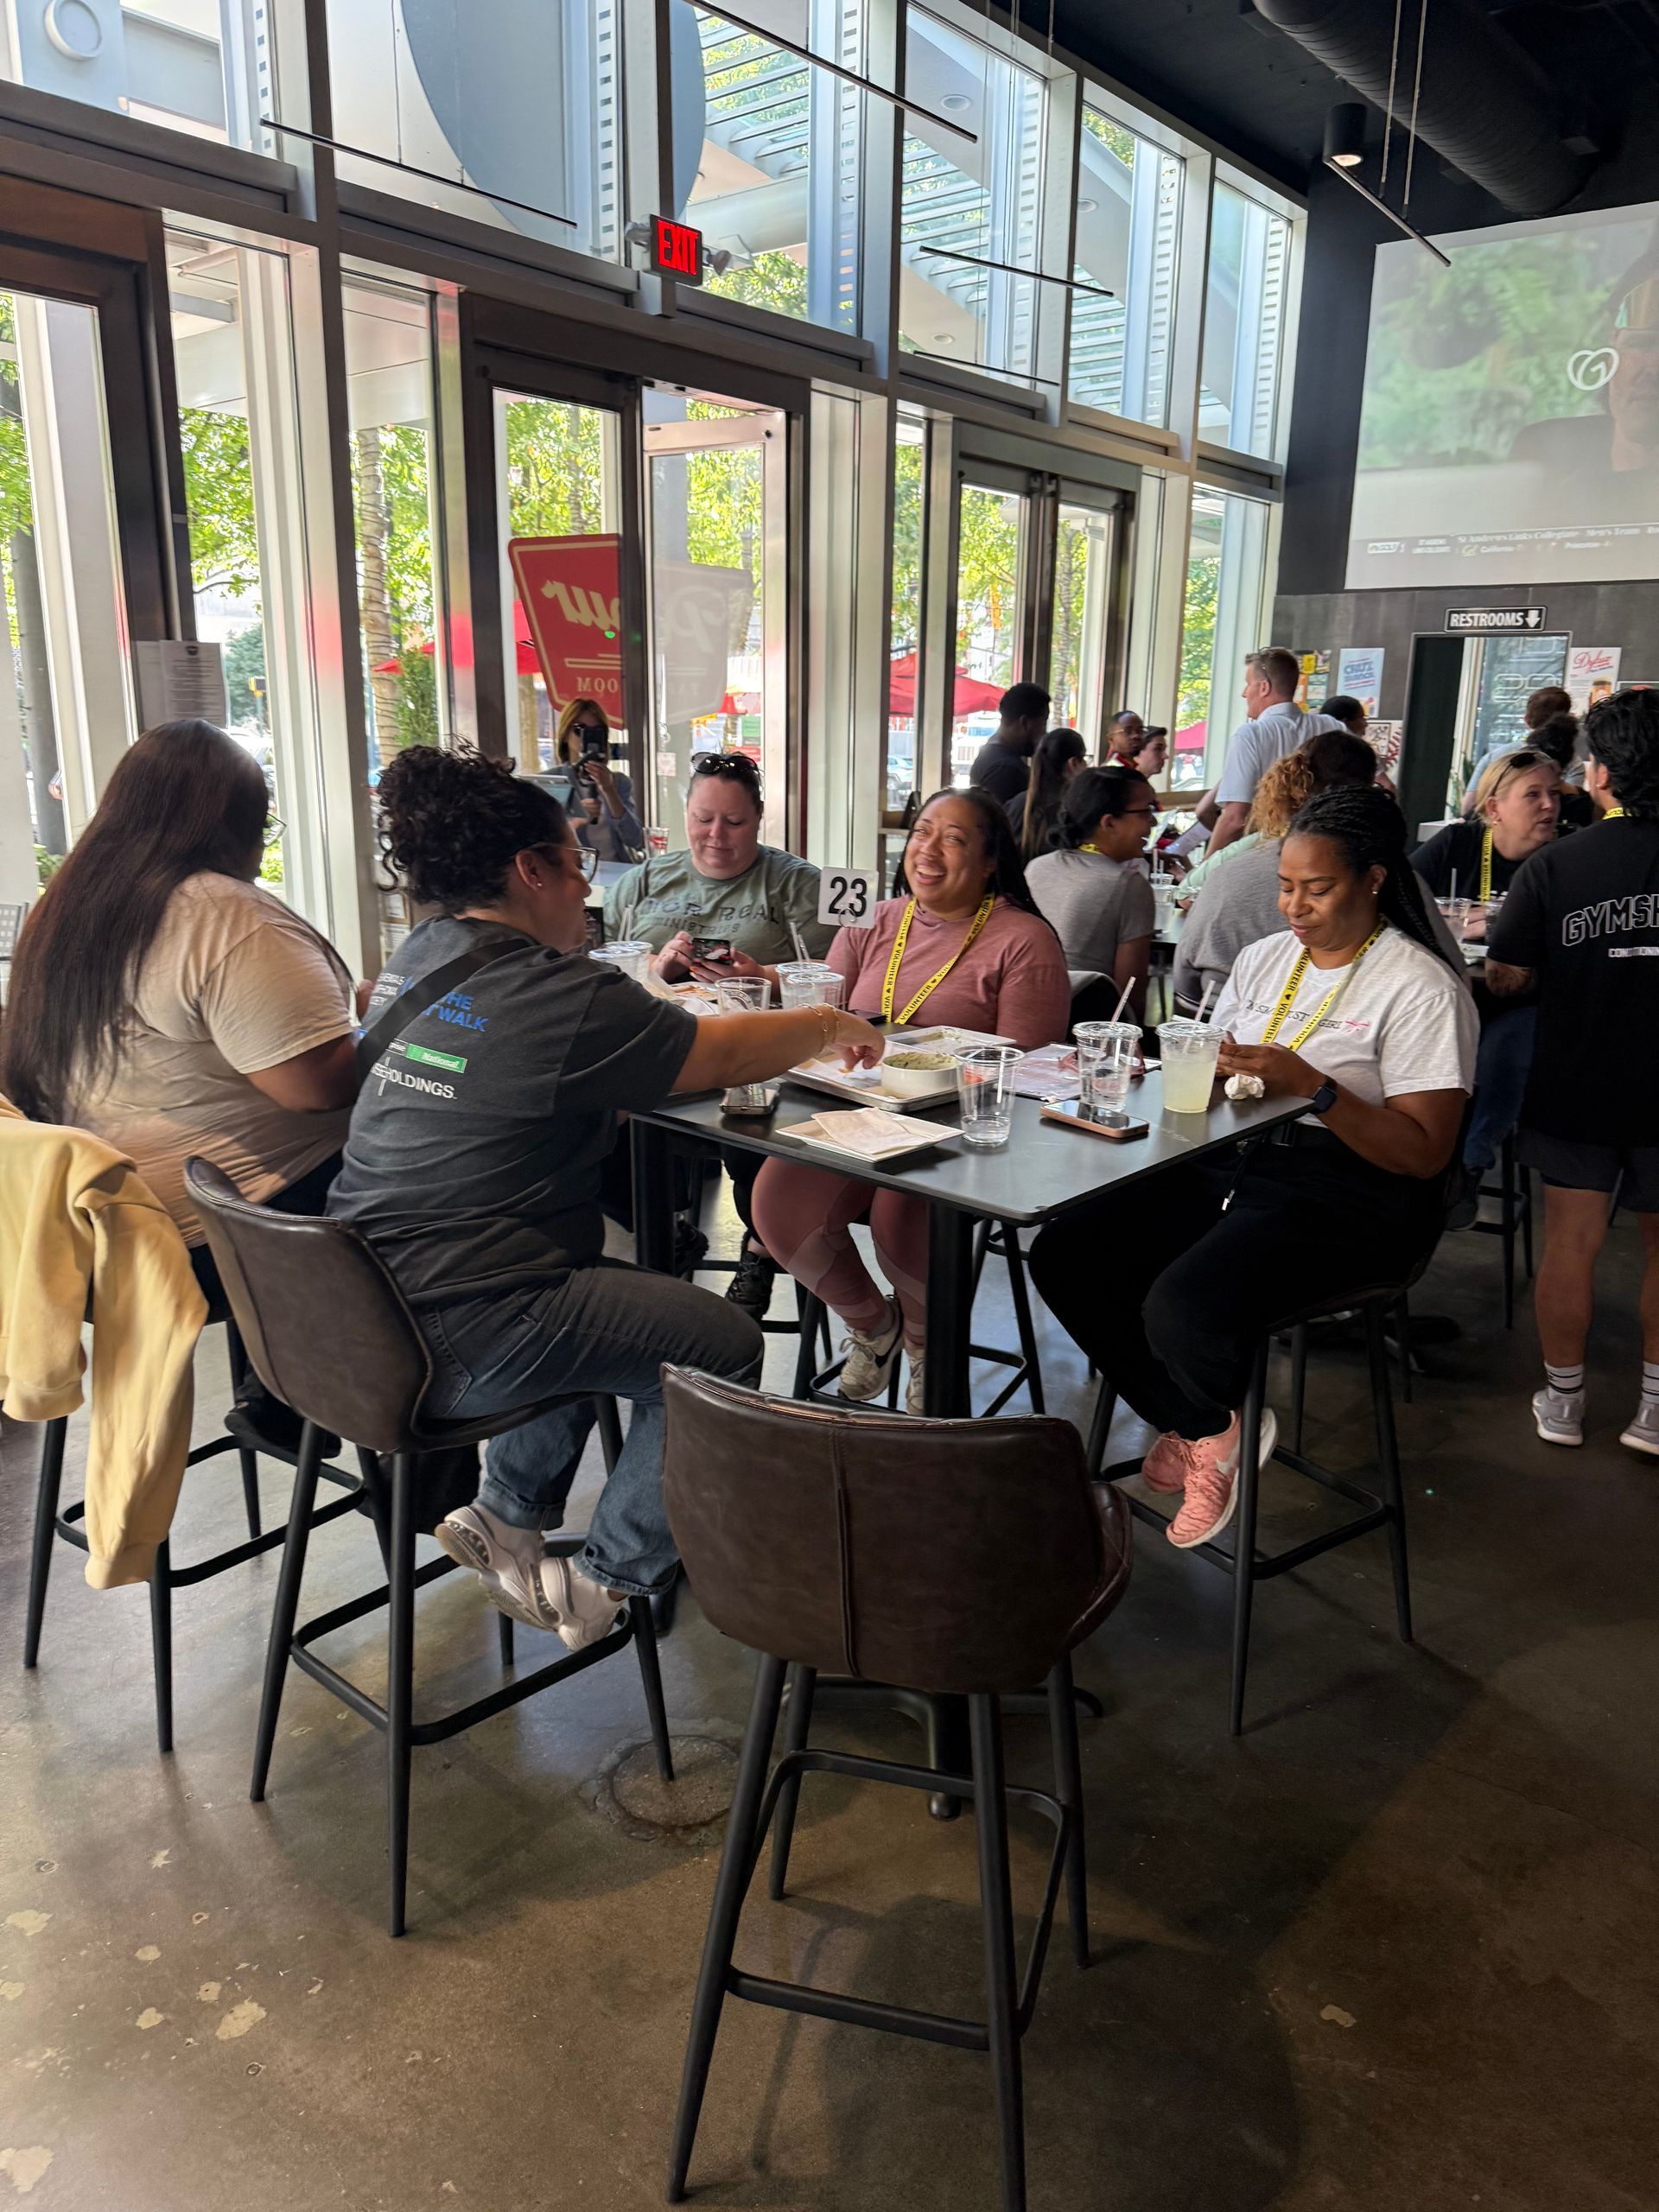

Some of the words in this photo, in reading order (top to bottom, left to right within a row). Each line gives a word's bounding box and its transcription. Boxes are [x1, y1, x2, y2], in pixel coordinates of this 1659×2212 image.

[658, 219, 698, 276] EXIT
[1450, 613, 1524, 626] RESTROOMS
[718, 904, 779, 925] REAL
[828, 875, 868, 918] 23
[887, 949, 902, 986] VOLUNTEER
[438, 1006, 489, 1033] WALK
[899, 984, 931, 1020] VOLUNTEER
